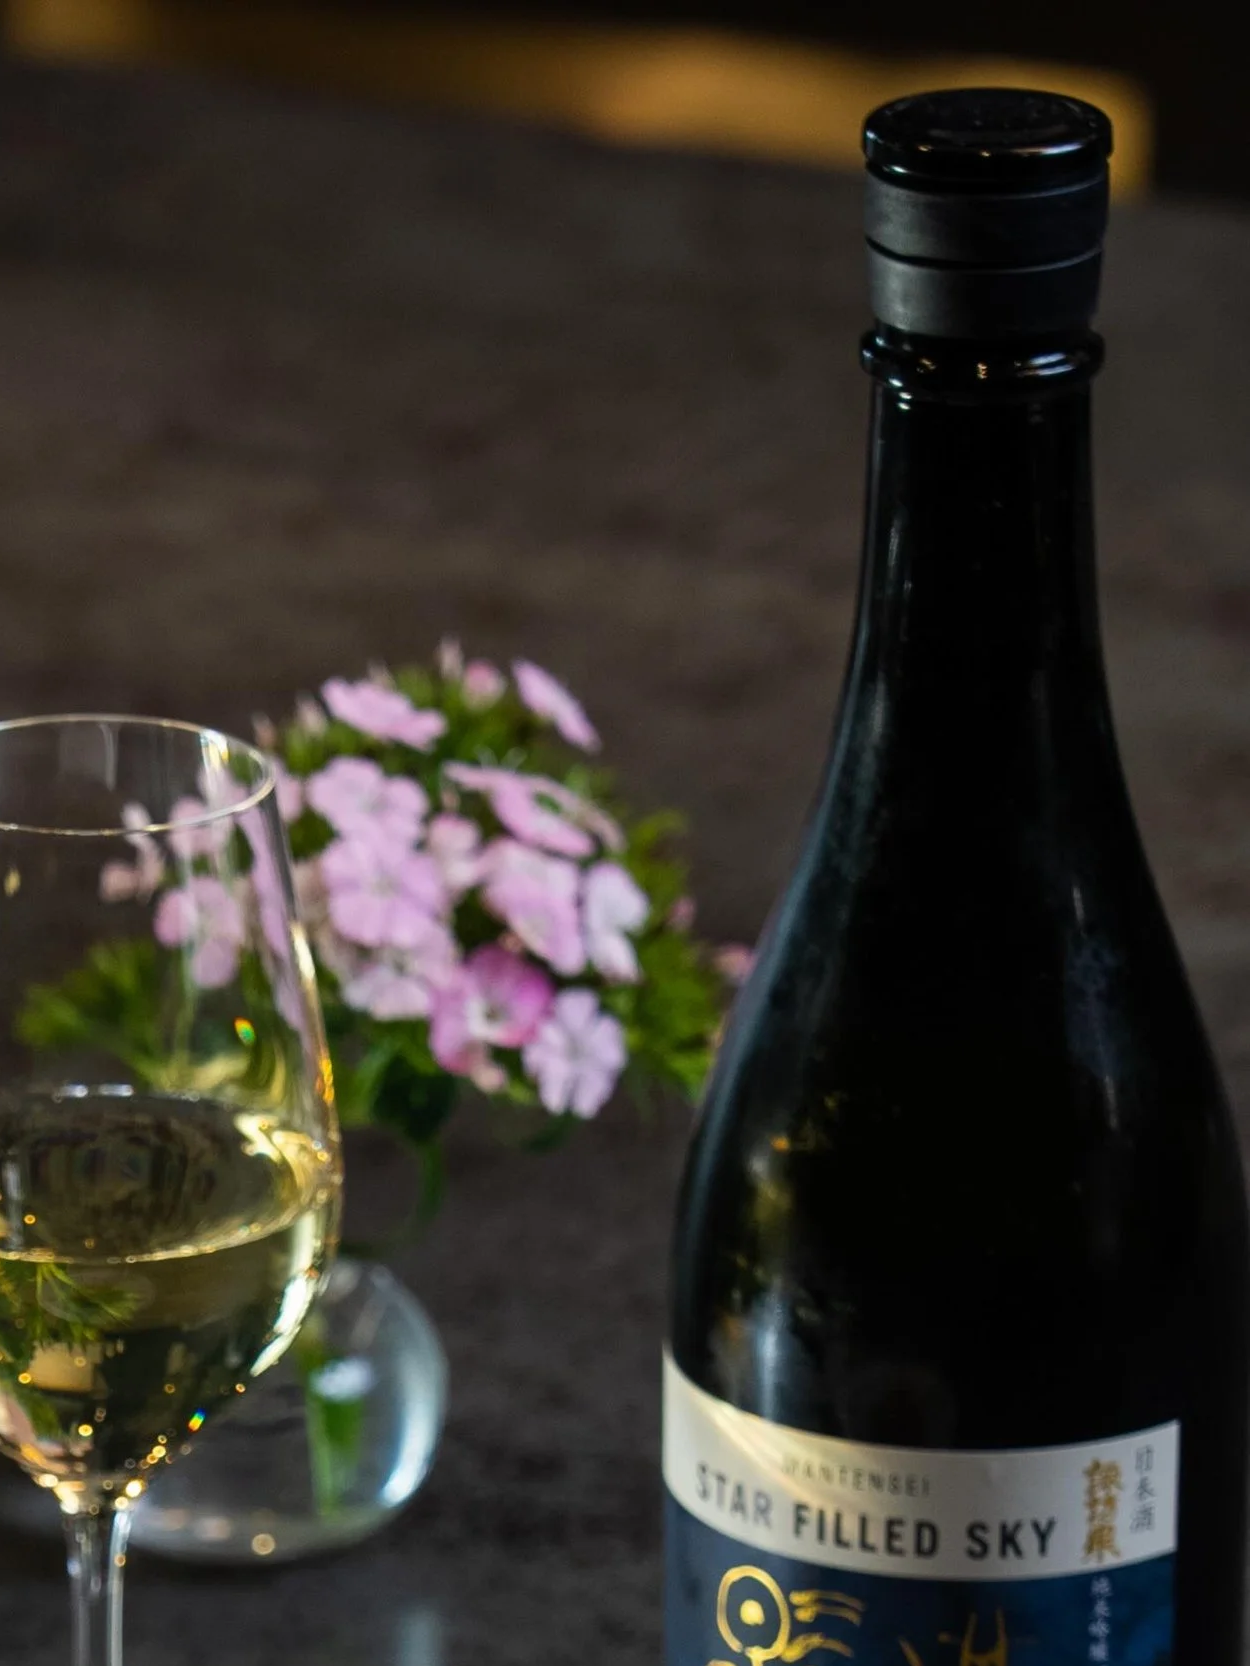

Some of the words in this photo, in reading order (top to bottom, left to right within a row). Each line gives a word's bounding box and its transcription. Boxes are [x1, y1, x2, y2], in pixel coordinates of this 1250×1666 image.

[696, 1462, 774, 1529] STAR
[793, 1502, 940, 1559] FILLED
[964, 1516, 1057, 1562] SKY
